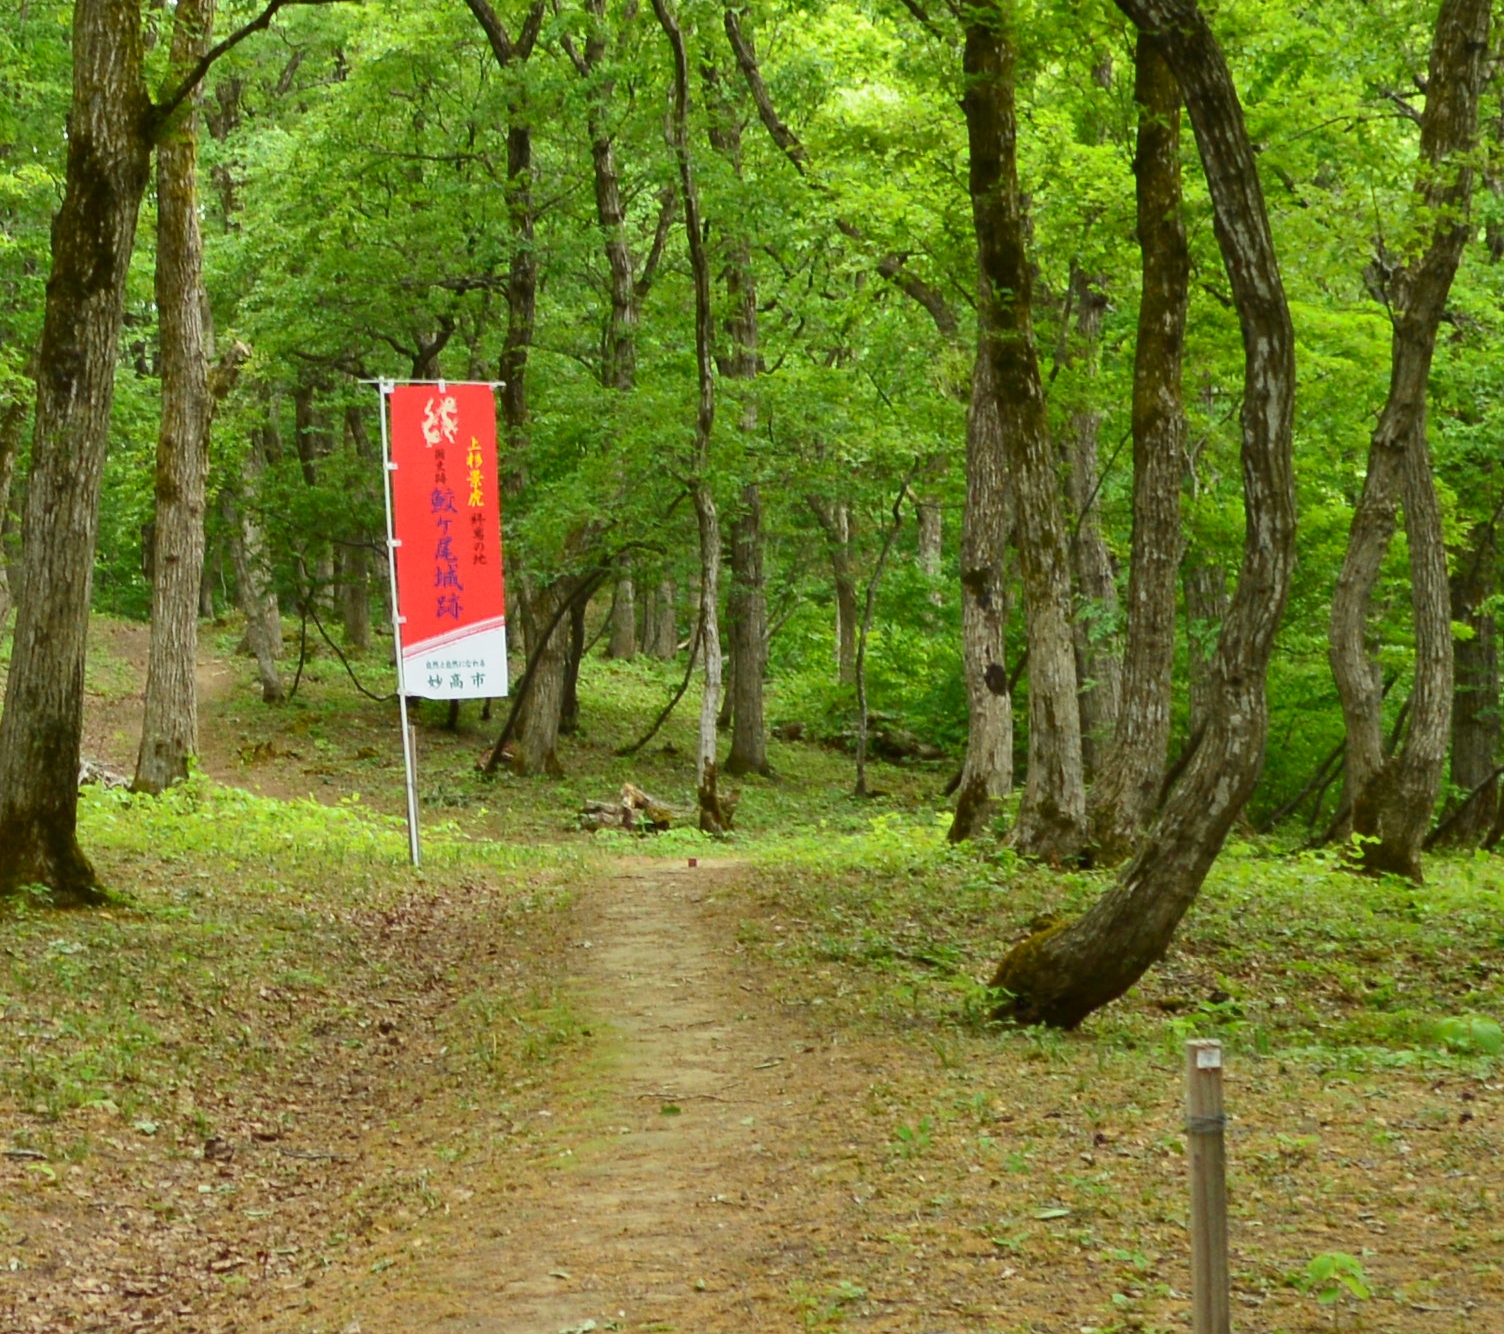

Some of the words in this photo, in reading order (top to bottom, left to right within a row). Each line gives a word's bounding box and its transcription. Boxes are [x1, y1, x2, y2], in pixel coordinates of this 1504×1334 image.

[466, 436, 484, 507] 上杉景虎
[427, 672, 486, 689] 妙高市
